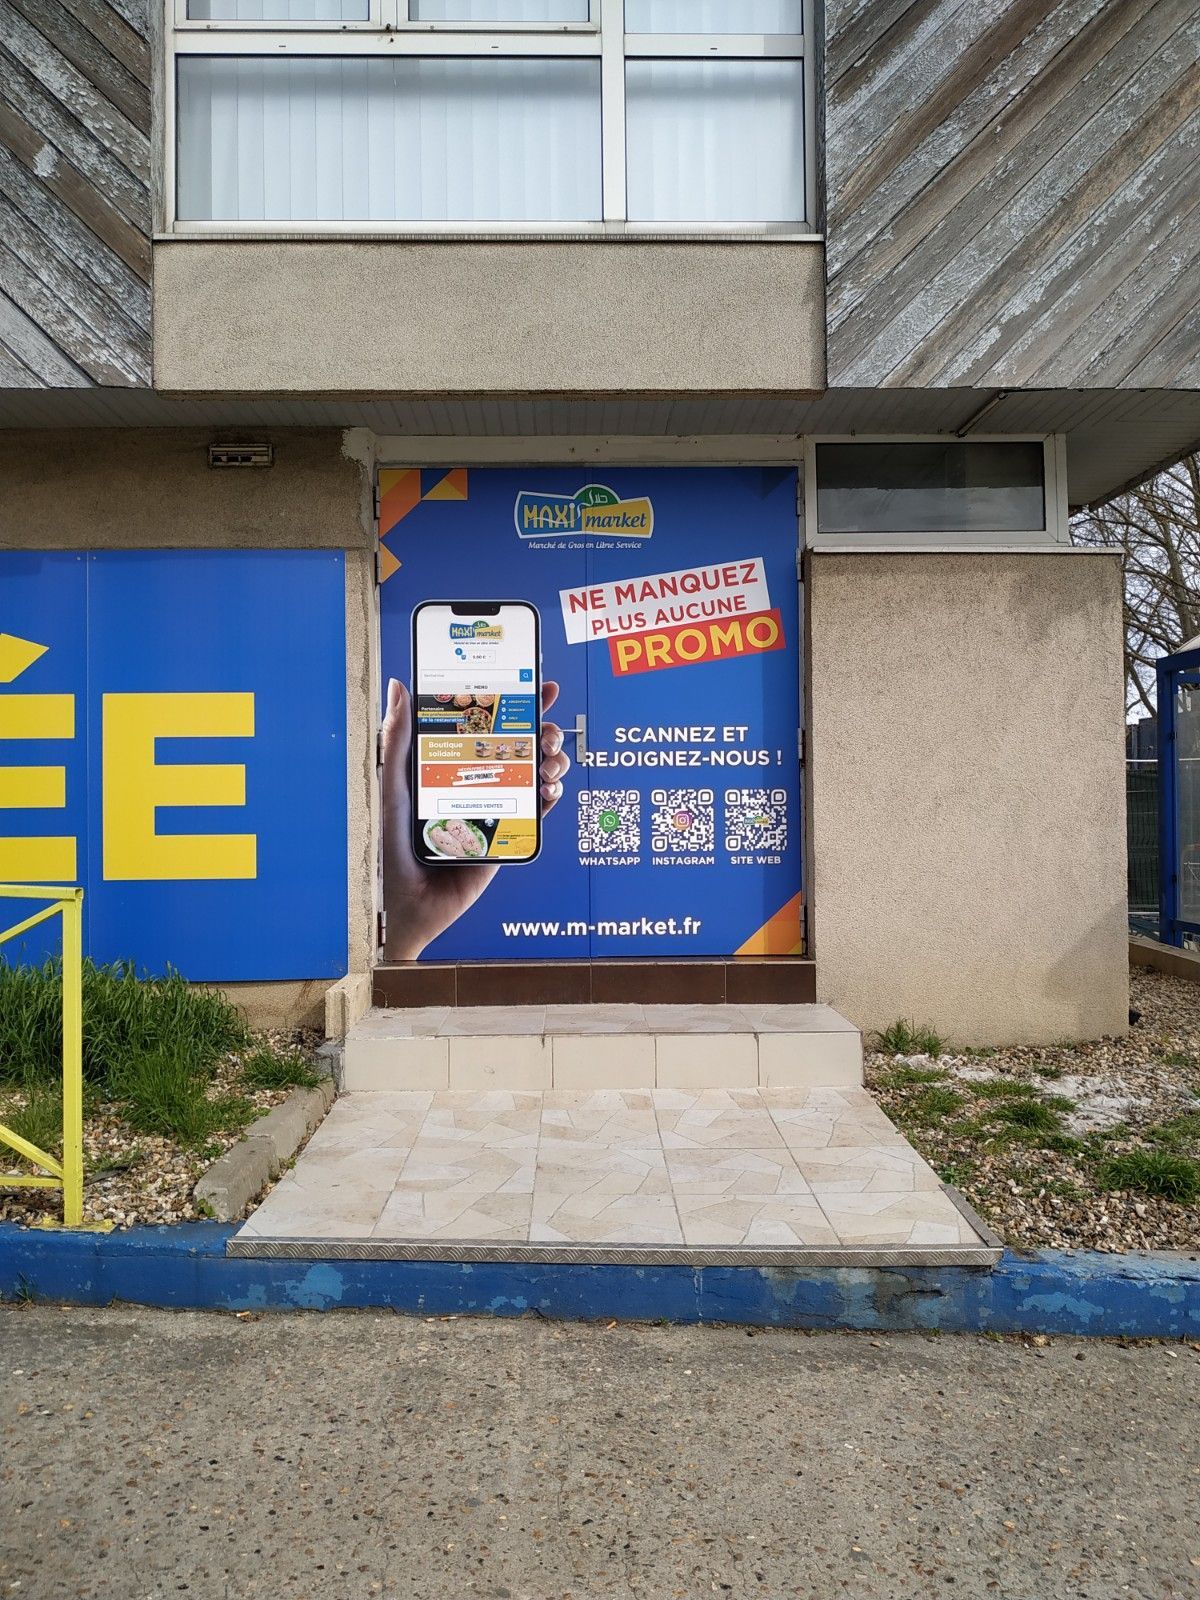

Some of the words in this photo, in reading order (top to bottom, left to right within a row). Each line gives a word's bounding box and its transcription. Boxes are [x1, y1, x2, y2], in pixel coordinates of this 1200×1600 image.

[585, 511, 647, 528] market
[528, 541, 556, 549] Marché
[557, 541, 567, 549] de
[568, 541, 584, 549] Gros
[595, 541, 615, 549] Libre
[616, 541, 642, 549] Service
[568, 588, 607, 614] NE
[614, 562, 758, 606] MANQUEZ
[591, 611, 647, 636] PLUS
[654, 594, 747, 626] AUCUNE
[476, 628, 502, 638] market
[616, 616, 779, 672] PROMO
[614, 727, 716, 743] SCANNEZ
[722, 727, 748, 742] ET
[582, 751, 770, 767] REJOIGNEZ-NOUS
[777, 750, 782, 765] !
[579, 856, 641, 866] WHATSAPP
[652, 856, 715, 866] INSTAGRAM
[730, 856, 753, 865] SITE
[756, 856, 781, 865] WEB
[501, 916, 701, 937] www.m-market.fr
